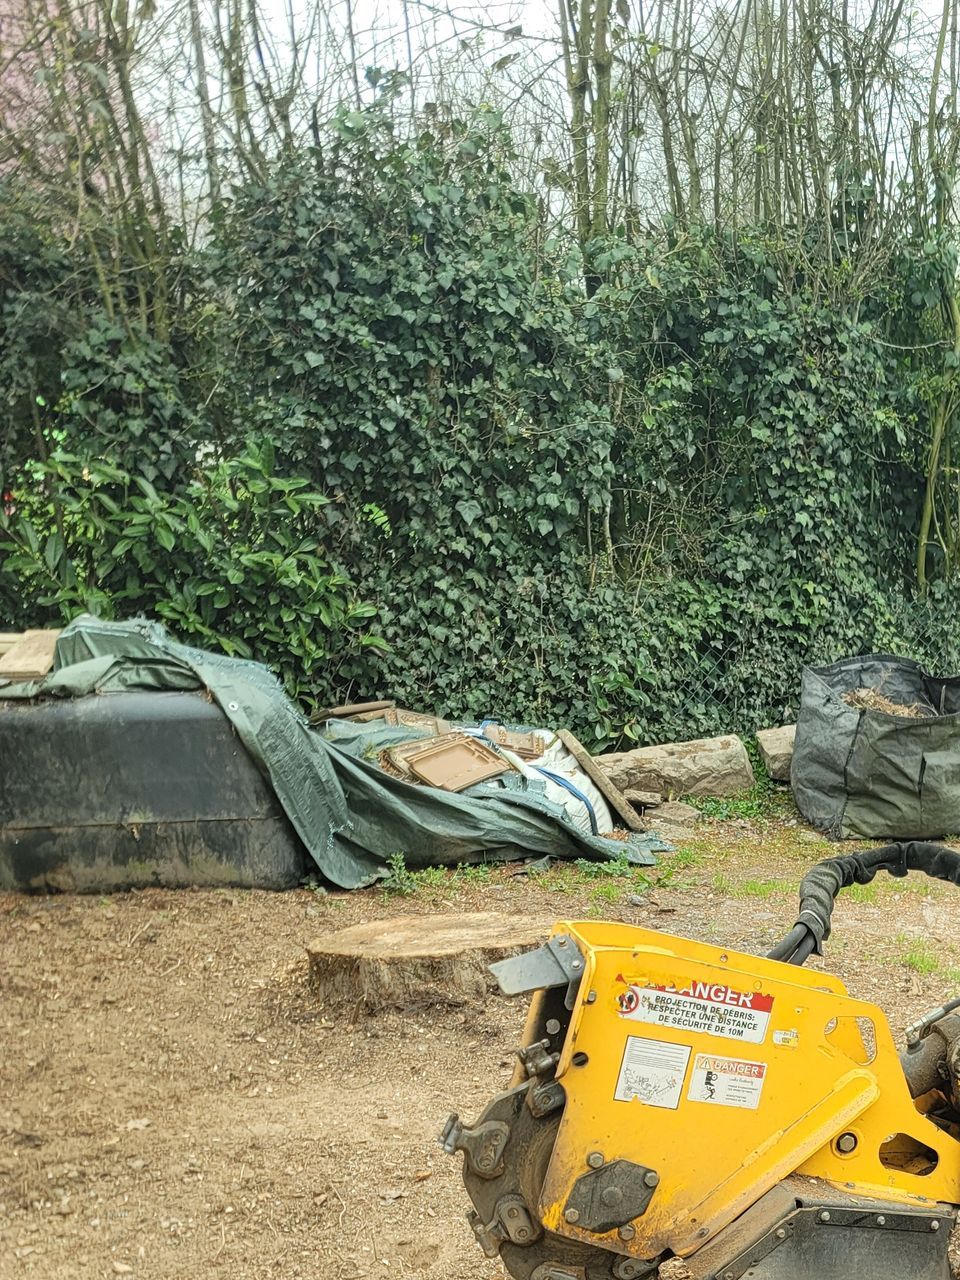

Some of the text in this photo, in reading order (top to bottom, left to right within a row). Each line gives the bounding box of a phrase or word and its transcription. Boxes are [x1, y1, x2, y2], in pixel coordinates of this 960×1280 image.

[648, 1003, 759, 1031] RESPECTER UNE DISTANCE
[655, 995, 755, 1021] PROJECTION DE DÉBRIS:
[658, 1014, 744, 1037] DE SÉCURITÉ DE 10M
[714, 1061, 759, 1075] DANGER
